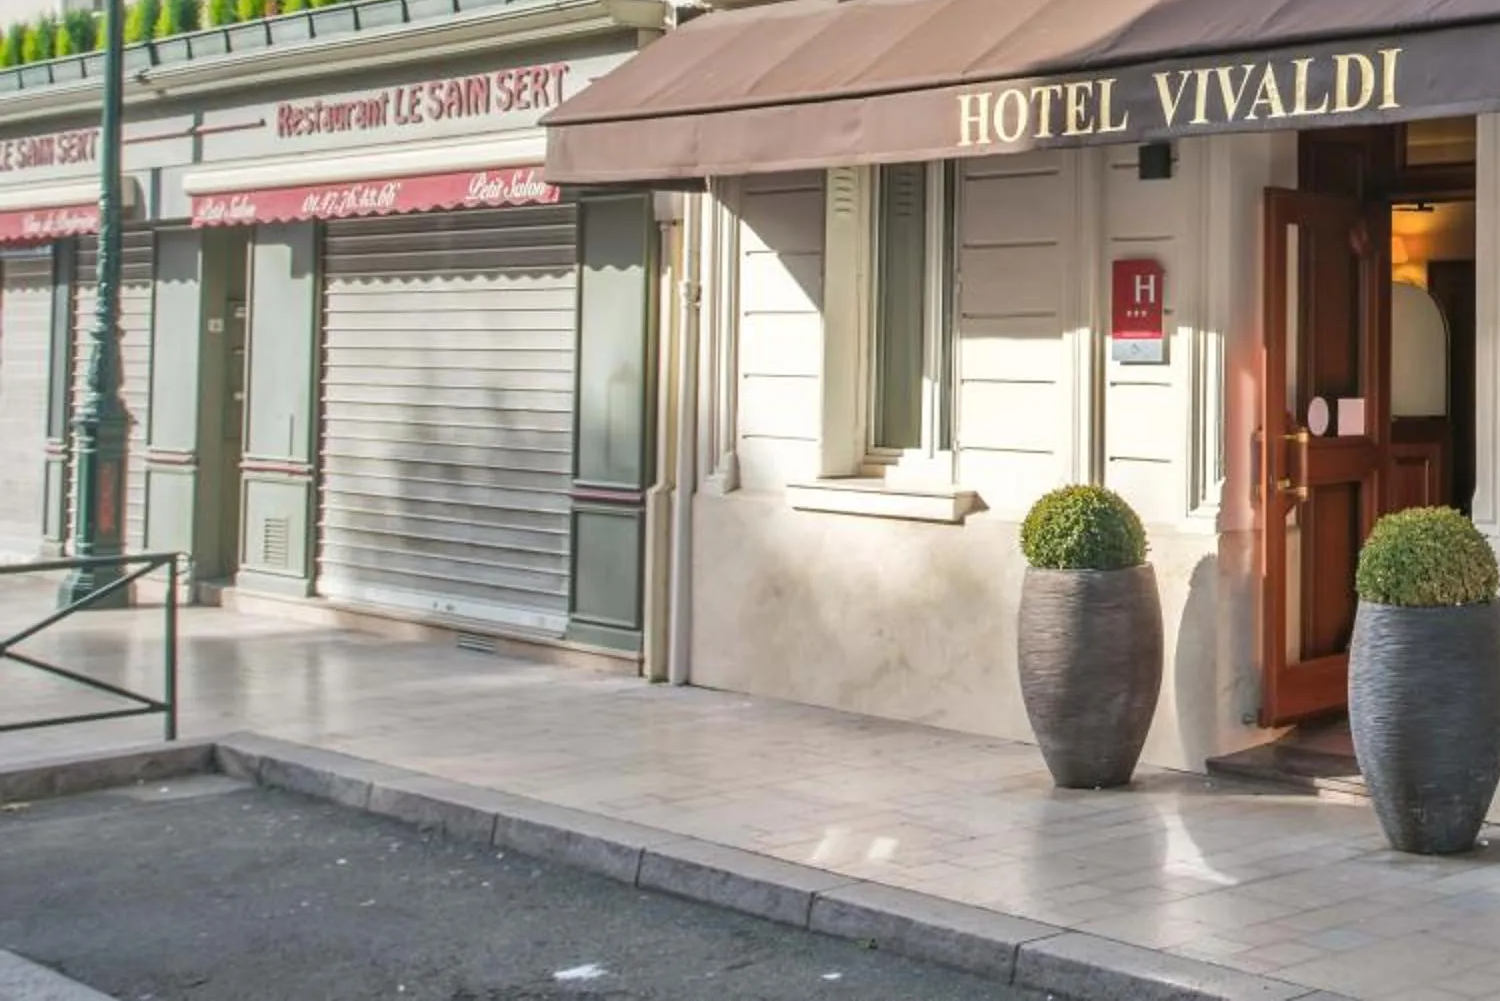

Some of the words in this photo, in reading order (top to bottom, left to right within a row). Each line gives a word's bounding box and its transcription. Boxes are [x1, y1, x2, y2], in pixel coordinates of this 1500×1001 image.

[277, 91, 391, 138] Restaurant
[393, 85, 425, 126] LE
[426, 73, 492, 121] SAIN
[495, 61, 570, 112] SERT
[956, 77, 1130, 147] HOTEL
[1151, 47, 1404, 128] VIVALDI
[464, 171, 505, 200] Petit
[1134, 274, 1155, 303] H
